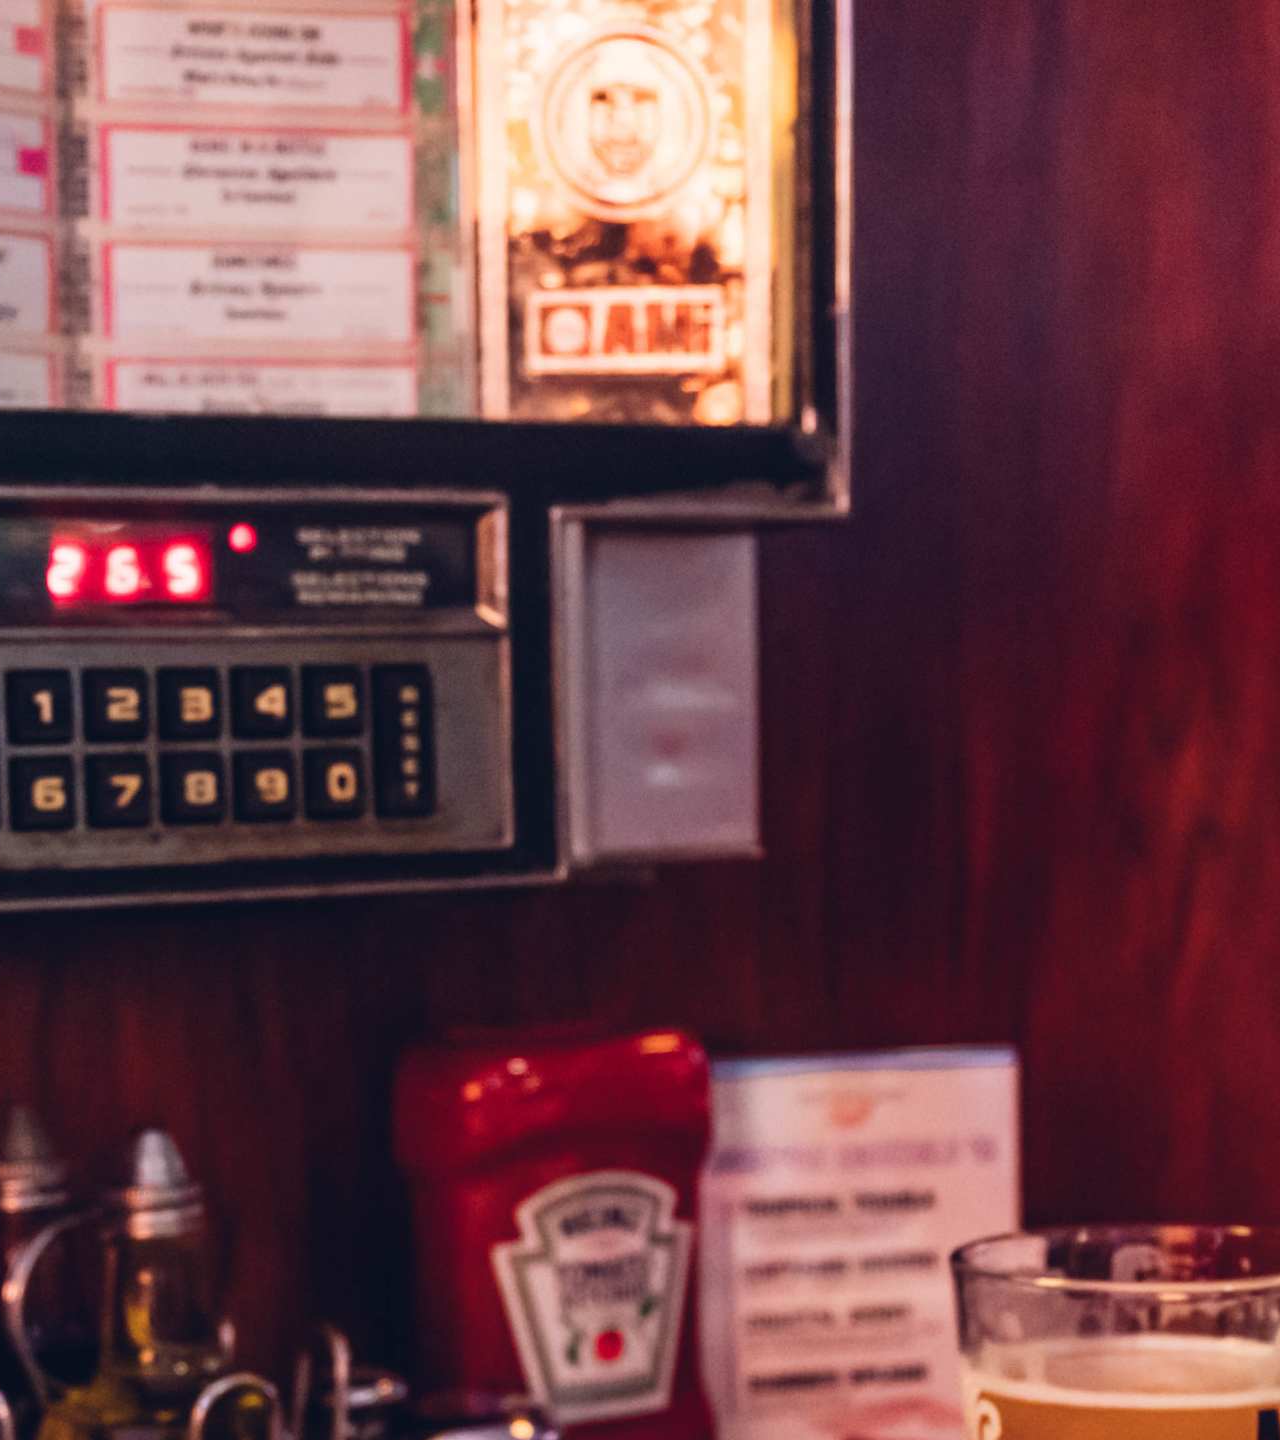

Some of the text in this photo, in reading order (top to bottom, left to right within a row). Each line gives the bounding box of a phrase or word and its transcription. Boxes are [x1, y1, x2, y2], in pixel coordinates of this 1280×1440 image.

[33, 684, 357, 724] 1 2 3 4 5
[32, 763, 357, 811] 6 7 8 9 0
